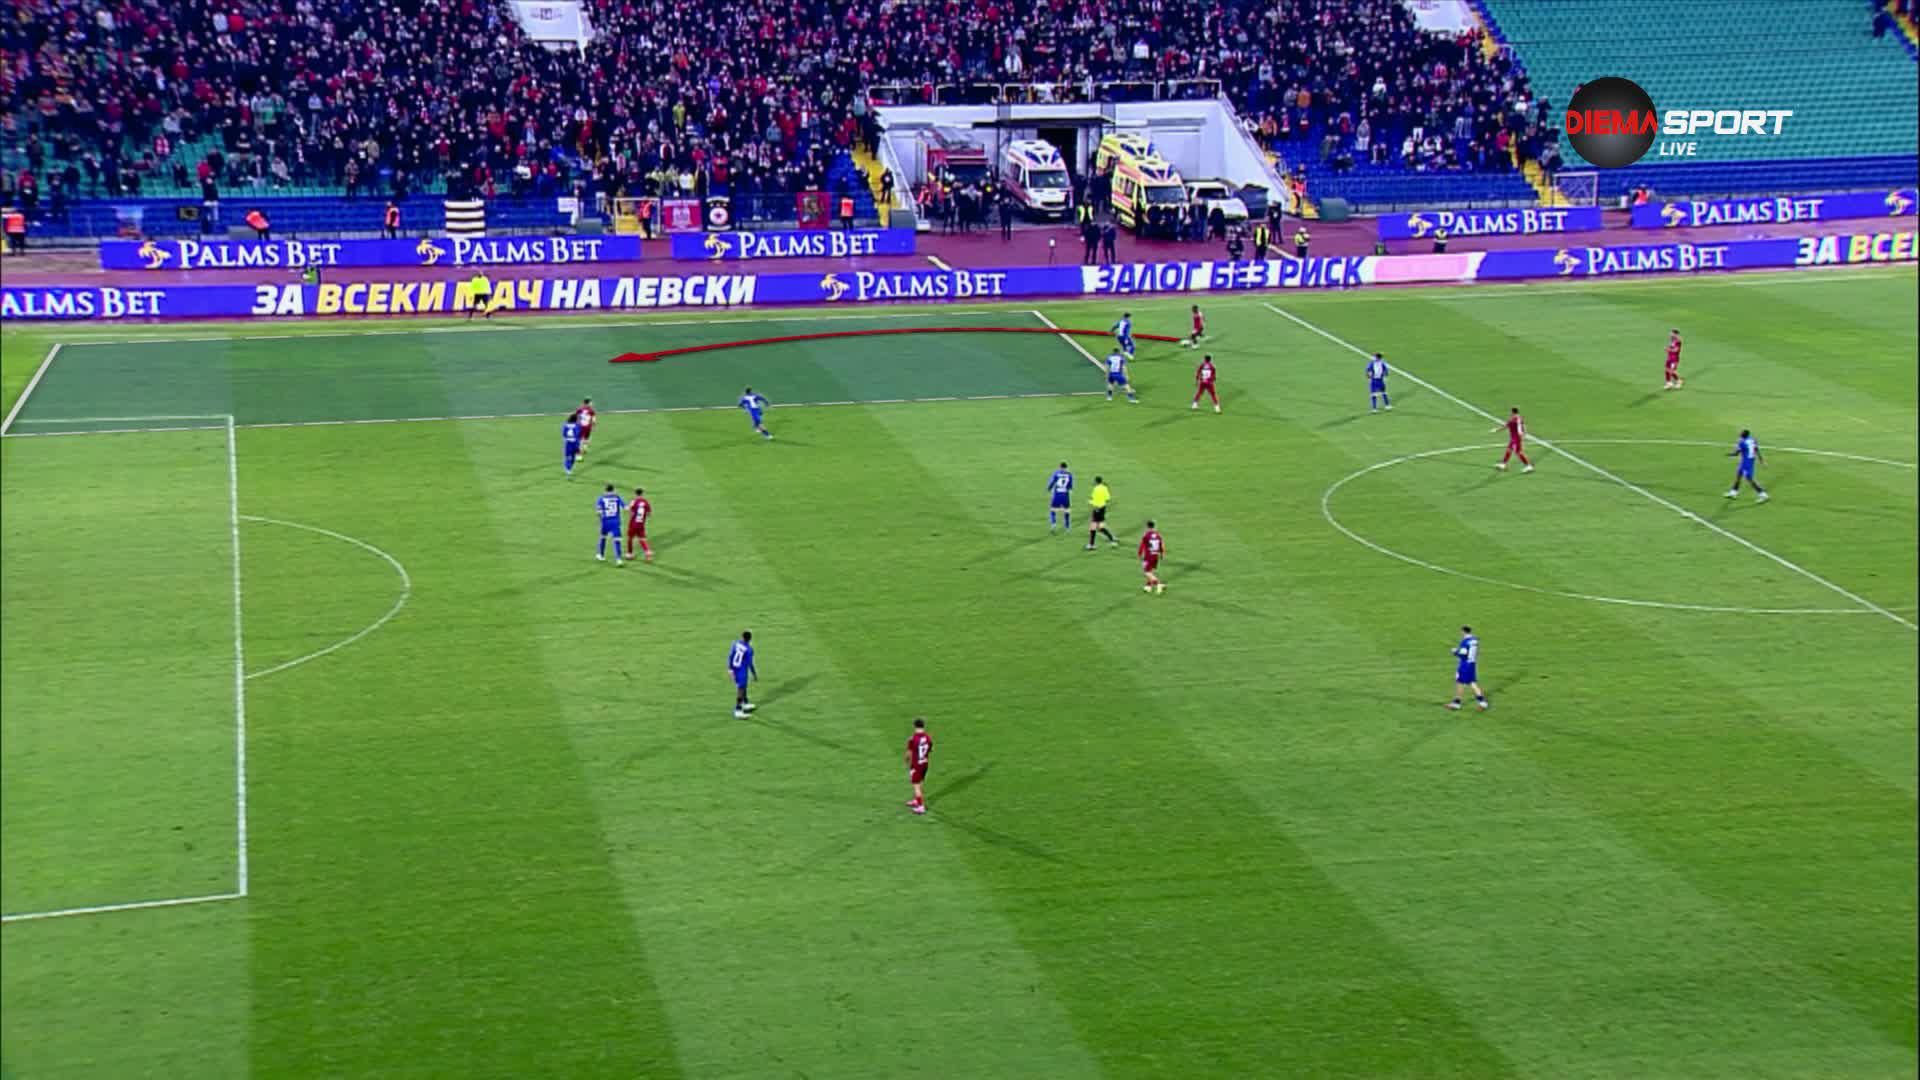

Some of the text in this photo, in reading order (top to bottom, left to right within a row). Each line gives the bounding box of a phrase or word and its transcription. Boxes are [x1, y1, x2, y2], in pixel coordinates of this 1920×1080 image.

[1095, 257, 1366, 292] ЗАЛОГ БЕЗ РИСК
[252, 285, 304, 315] ЗА
[316, 282, 446, 313] ВСЕКИ
[549, 277, 603, 309] НА
[611, 275, 756, 306] ЛЕВСКИ
